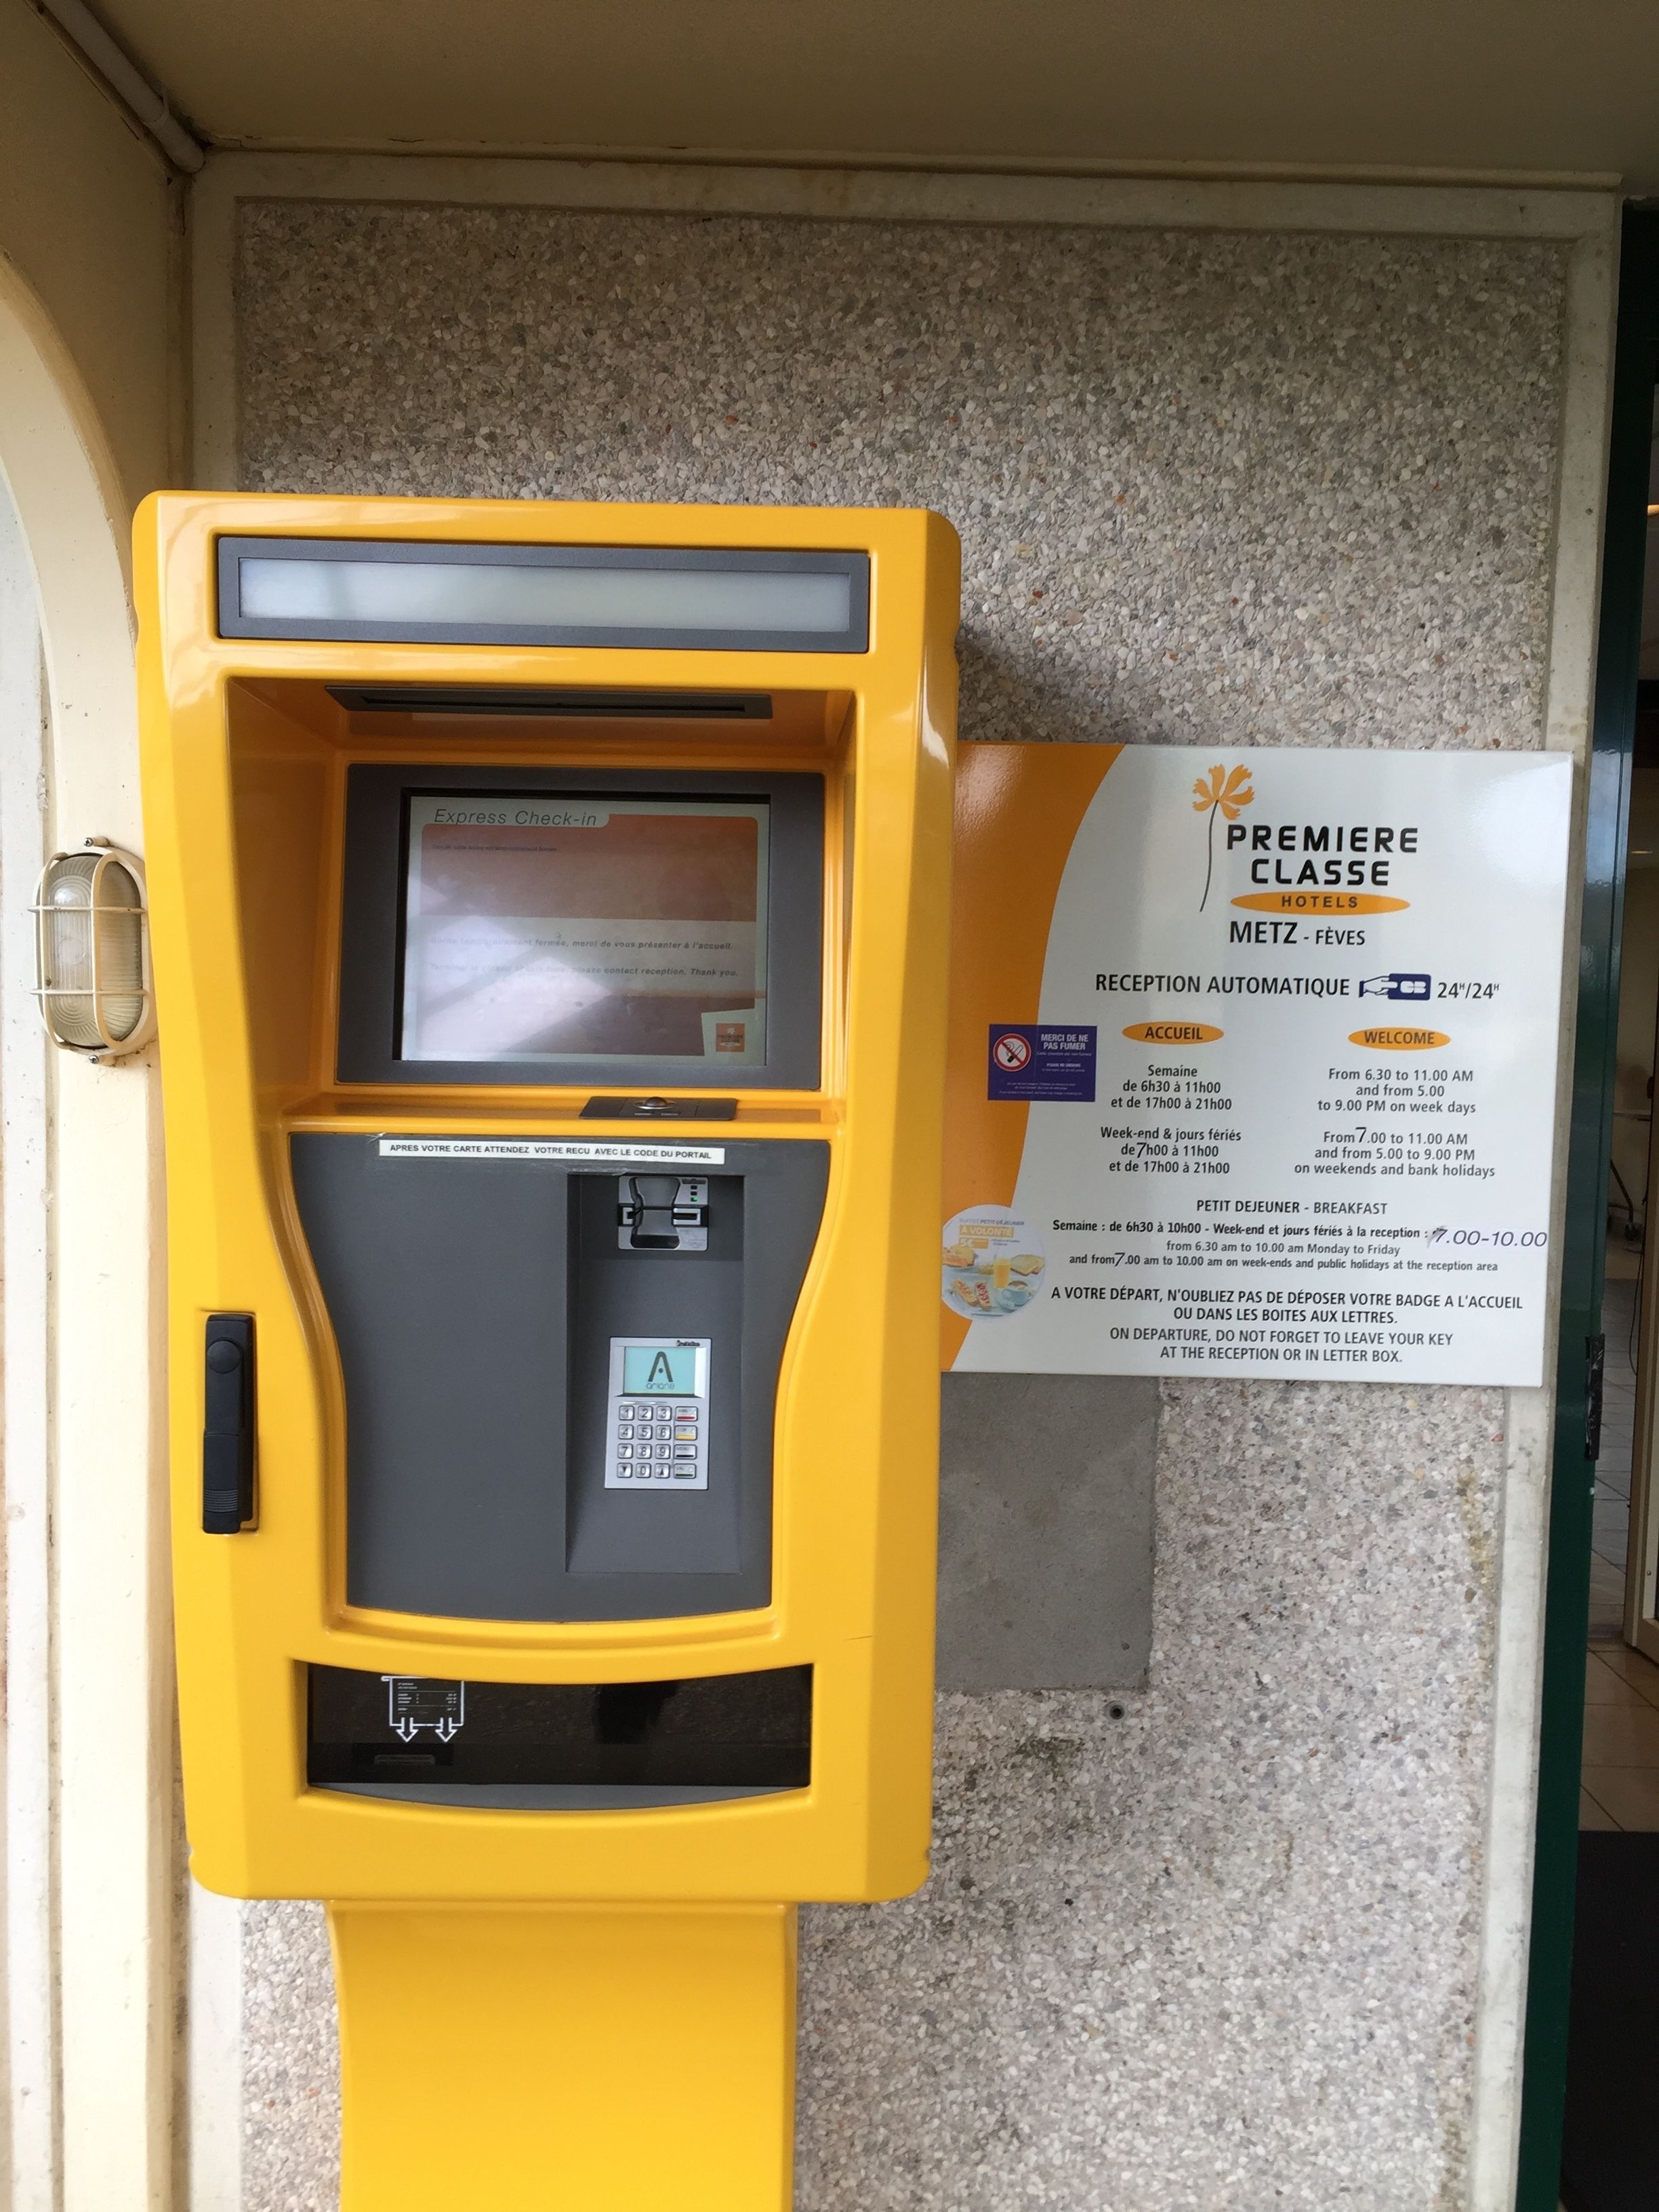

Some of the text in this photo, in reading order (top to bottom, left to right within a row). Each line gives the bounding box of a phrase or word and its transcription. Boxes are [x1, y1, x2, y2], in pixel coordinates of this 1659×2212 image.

[434, 808, 597, 826] Express Check-in
[1227, 824, 1418, 854] PREMIERE
[1251, 858, 1389, 886] CLASSE
[1282, 895, 1359, 909] HOTELS
[1230, 920, 1365, 945] METZ FÈVES
[1096, 974, 1200, 993] RECEPTION
[1206, 976, 1350, 998] AUTOMATIQUE
[1145, 1027, 1203, 1040] ACCUEIL
[1364, 1031, 1435, 1044] WELCOME
[1148, 1064, 1197, 1078] Semaine
[1329, 1067, 1473, 1082] From 6.30 to 11.00 AM
[1123, 1079, 1221, 1094] de 6h30 à 11h00
[1356, 1083, 1445, 1097] and from 5.00
[1111, 1095, 1232, 1110] et de 17h00 à 21h00
[1317, 1099, 1476, 1116] to 9.00 PM on week days
[1101, 1126, 1242, 1143] Week-end & jours fériés
[1390, 1133, 1404, 1145] to
[1408, 1132, 1443, 1145] 11.00
[1446, 1133, 1469, 1145] AM
[390, 1144, 419, 1152] APRES
[453, 1145, 482, 1153] CARTE
[484, 1145, 529, 1153] ATTENDEZ
[634, 1149, 658, 1157] CODE
[675, 1151, 712, 1159] PORTAIL
[1172, 1145, 1179, 1157] à
[1183, 1145, 1220, 1158] 11h00
[1315, 1146, 1475, 1161] and from 5.00 to 9.00 PM
[1109, 1160, 1230, 1174] et de 17h00 à 21h00
[1294, 1162, 1495, 1180] on weekends and bank holidays
[1197, 1200, 1388, 1214] PETIT DEJEUNER BREAKFAST
[1052, 1219, 1097, 1231] Semaine
[1109, 1221, 1122, 1232] de
[1126, 1221, 1153, 1233] 6h30
[1157, 1221, 1164, 1233] à
[1168, 1222, 1202, 1234] 10h00
[1213, 1223, 1265, 1235] Week-end
[1269, 1225, 1279, 1235] et
[1282, 1224, 1310, 1237] jours
[1313, 1224, 1343, 1237] fériés
[1347, 1225, 1353, 1237] à
[1357, 1225, 1366, 1237] la
[1370, 1227, 1420, 1240] reception
[1166, 1240, 1400, 1258] from 6.30 am to 10.00 am Monday to Friday
[1069, 1254, 1088, 1264] and
[1143, 1257, 1159, 1265] am
[1162, 1255, 1173, 1266] to
[1176, 1255, 1204, 1266] 10.00
[1207, 1258, 1223, 1267] am
[1226, 1258, 1238, 1267] on
[1242, 1256, 1292, 1268] week-ends
[1295, 1258, 1314, 1268] and
[1317, 1258, 1347, 1270] public
[1351, 1258, 1389, 1271] holidays
[1393, 1260, 1404, 1270] at
[1407, 1260, 1422, 1270] the
[1427, 1261, 1473, 1273] reception
[1476, 1263, 1498, 1271] area
[1051, 1285, 1523, 1309] A VOTRE DÉPART, N'OUBLIEZ PAS DE DÉPOSER VOTRE BADGE A L'ACCUEIL
[1174, 1307, 1397, 1324] OU DANS LES BOITES AUX LETTRES.
[1110, 1327, 1453, 1345] ON DEPARTURE, DO NOT FORGET TO LEAVE YOUR KEY
[1160, 1346, 1402, 1363] AT THE RECEPTION OR IN LETTER BOX.
